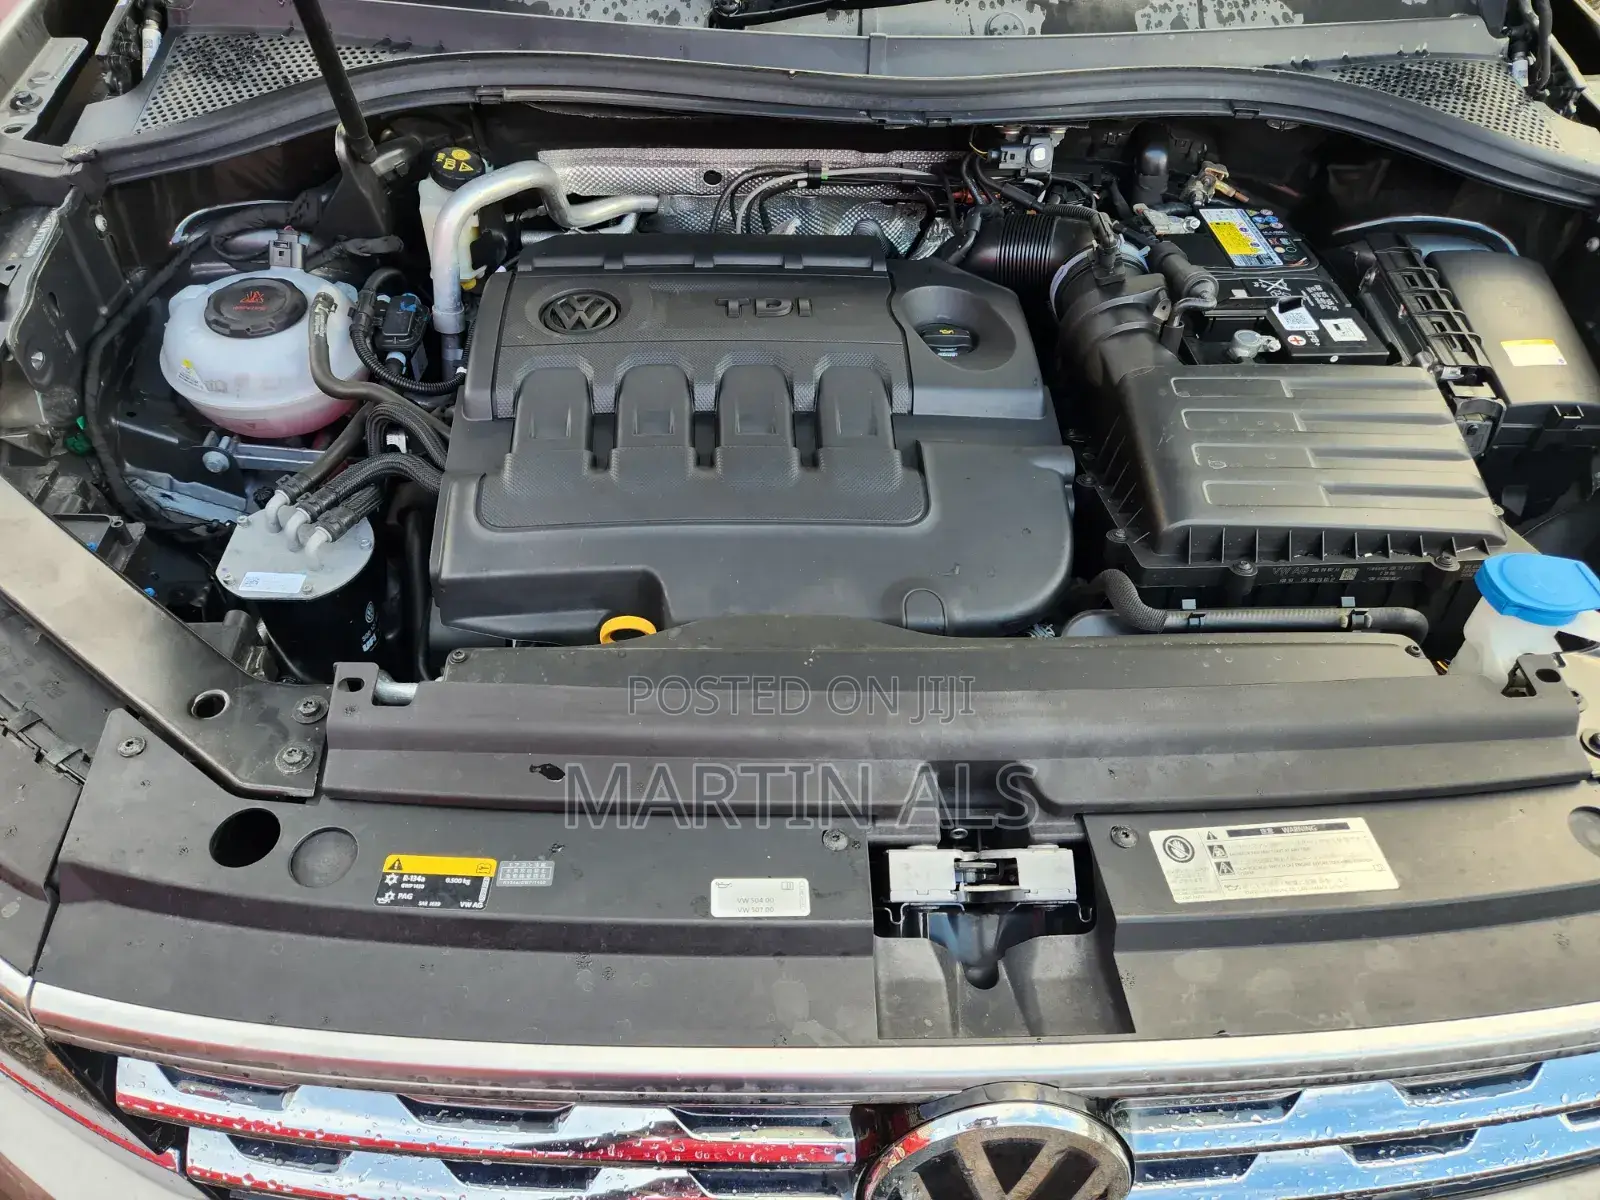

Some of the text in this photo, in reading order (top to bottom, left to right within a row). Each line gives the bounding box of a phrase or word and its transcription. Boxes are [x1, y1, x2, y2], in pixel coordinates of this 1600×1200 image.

[713, 297, 813, 318] TDI
[1281, 825, 1318, 835] WARNING
[402, 874, 426, 883] R-134a
[463, 877, 472, 886] kg
